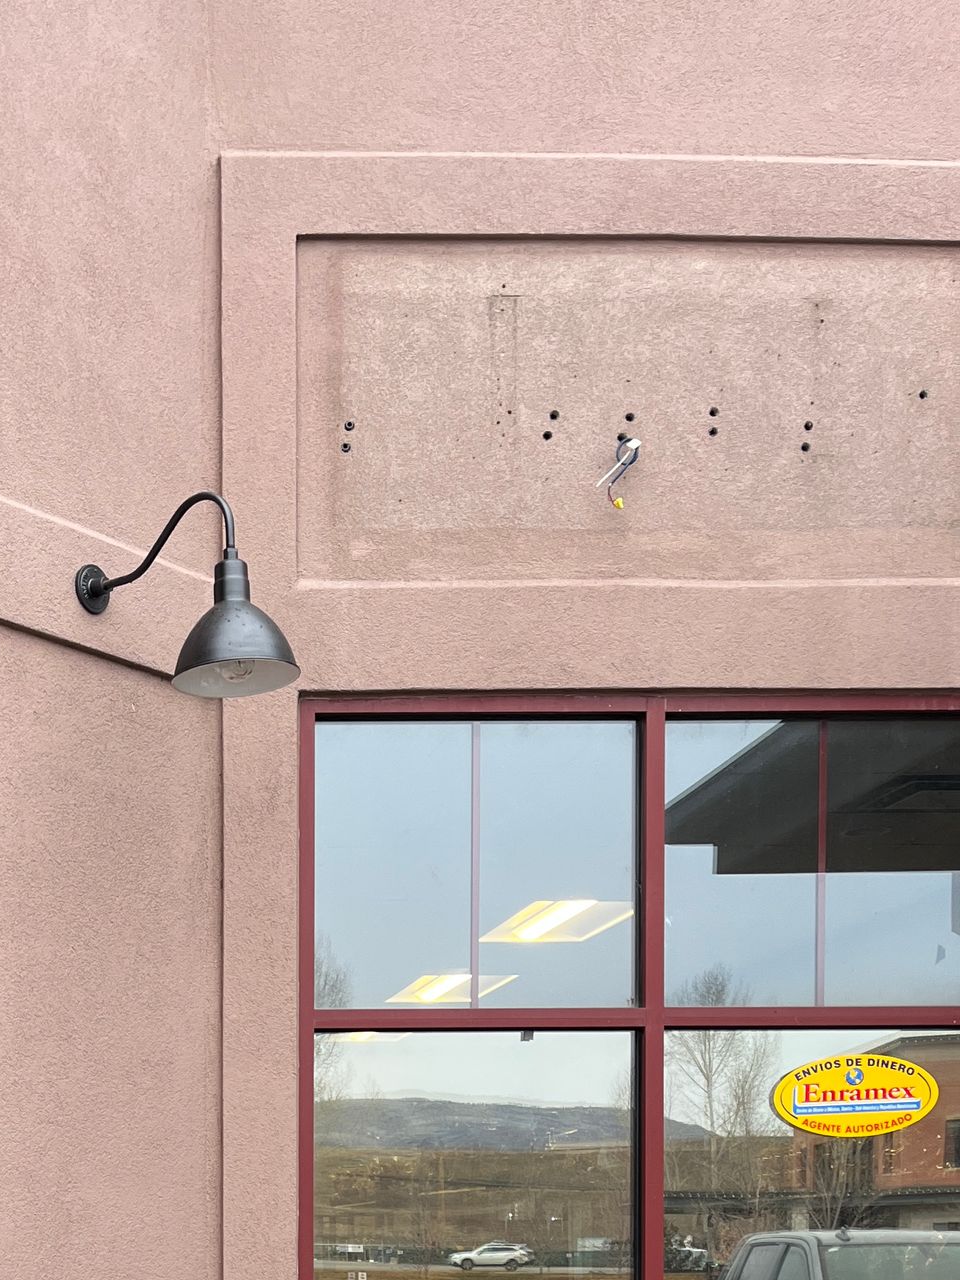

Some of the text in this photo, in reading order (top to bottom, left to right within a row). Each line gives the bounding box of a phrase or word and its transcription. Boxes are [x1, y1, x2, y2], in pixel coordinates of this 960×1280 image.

[794, 1058, 915, 1082] ENVIOS DE DINERO
[802, 1083, 917, 1104] Enramex
[802, 1113, 913, 1134] AGENTE AUTORIZADO
